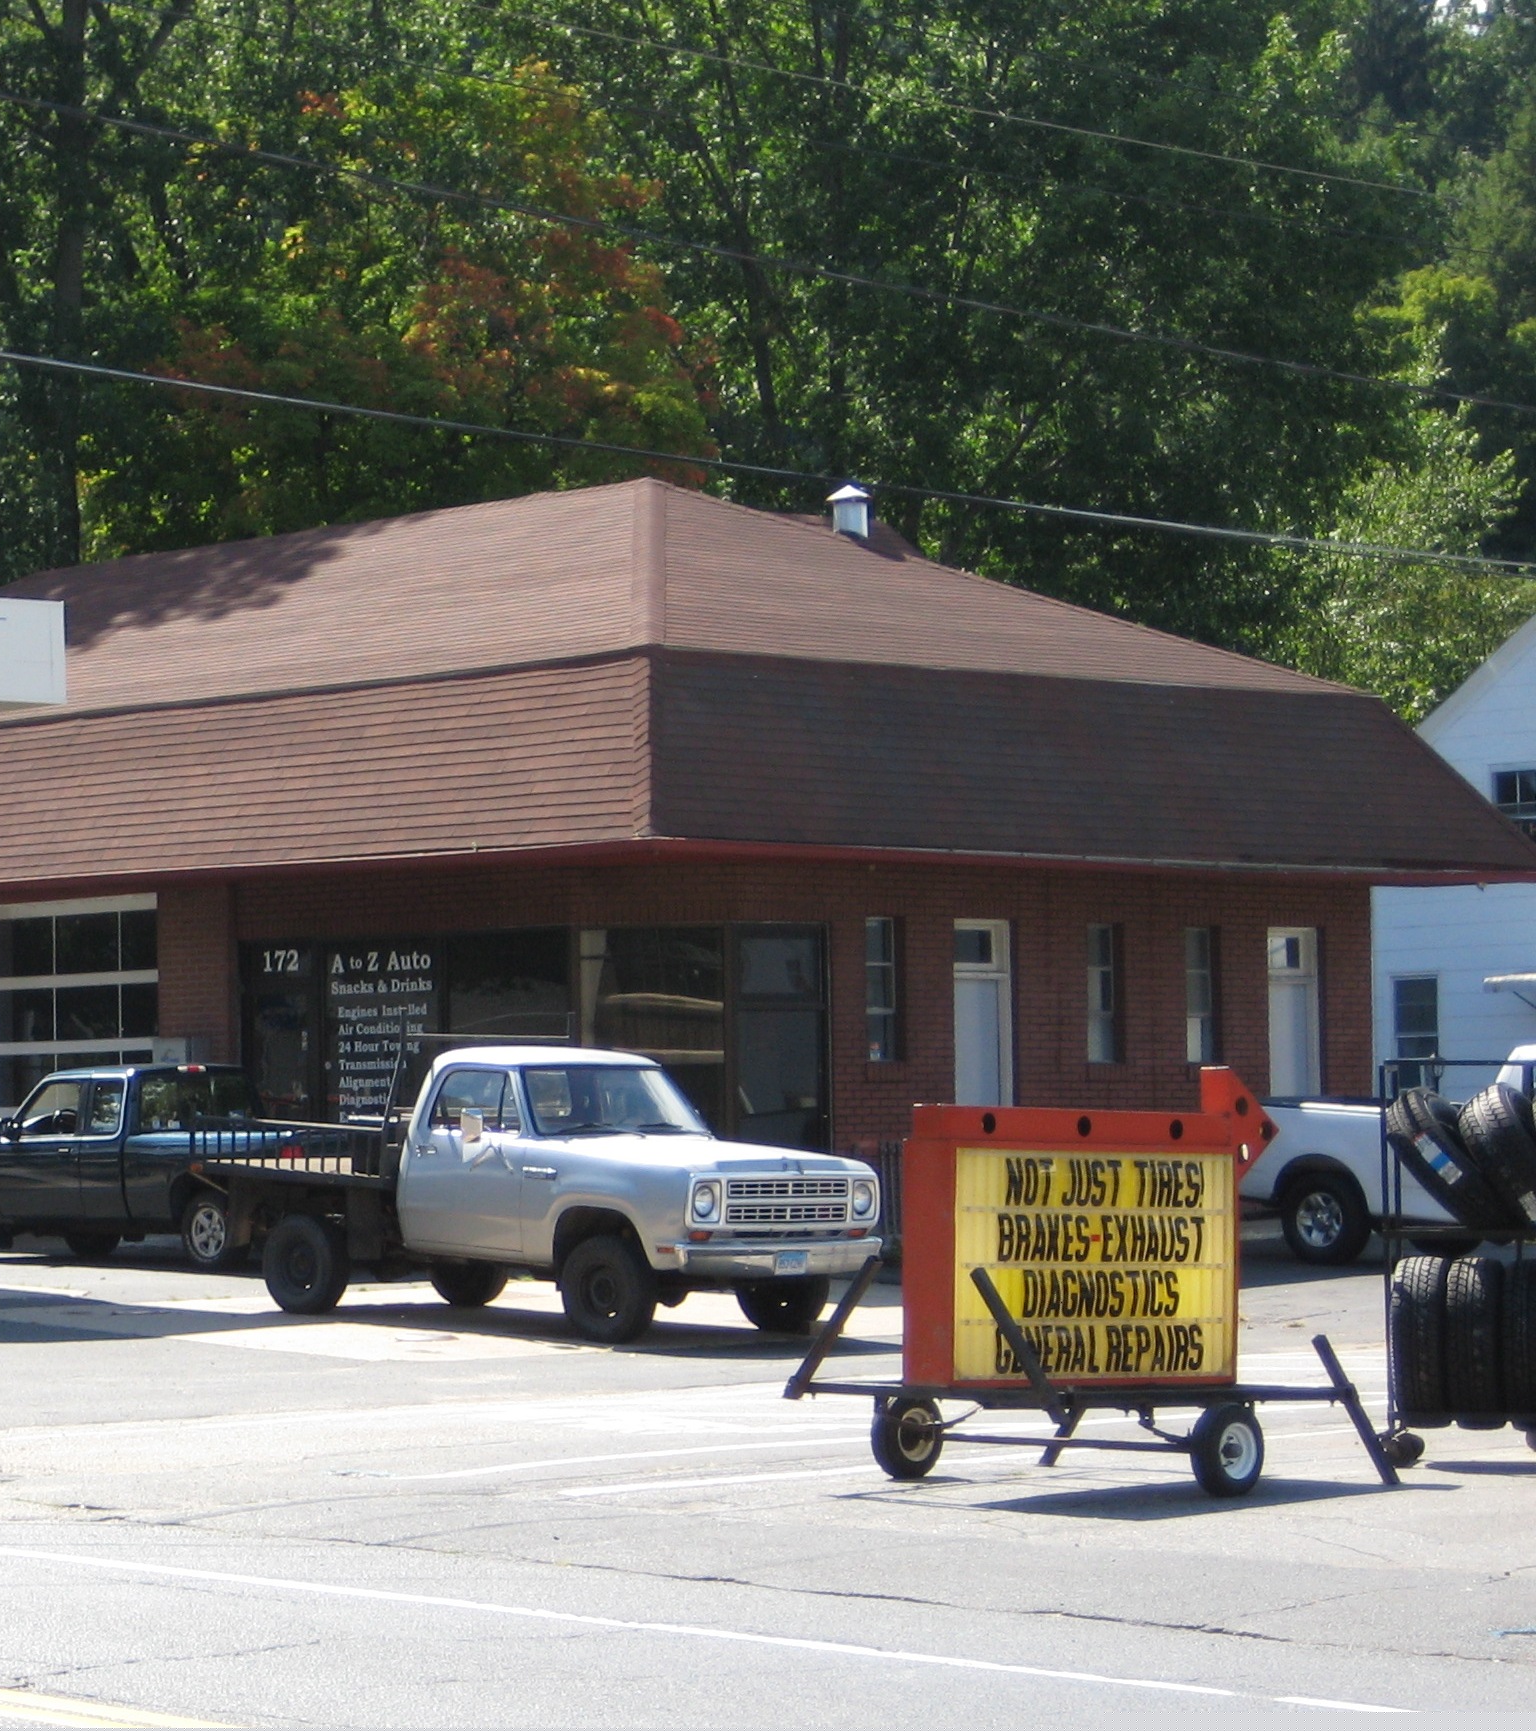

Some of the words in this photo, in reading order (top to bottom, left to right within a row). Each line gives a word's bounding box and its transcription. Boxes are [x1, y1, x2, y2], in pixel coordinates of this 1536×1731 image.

[264, 950, 299, 972] 172
[331, 953, 345, 974] A
[350, 956, 363, 970] to
[367, 951, 379, 971] Z
[387, 950, 432, 971] Auto
[331, 980, 374, 995] Snacks
[377, 980, 387, 993] &
[391, 977, 433, 993] Drinks
[338, 1006, 378, 1021] Engines
[382, 1003, 427, 1016] Instlled
[338, 1024, 354, 1036] Air
[356, 1020, 424, 1034] Conditioing
[338, 1041, 351, 1053] 24
[354, 1041, 379, 1052] Hour
[382, 1040, 420, 1054] Towng
[338, 1076, 392, 1091] Alignment
[1005, 1157, 1055, 1206] NOT
[1061, 1159, 1122, 1207] JUST
[1134, 1160, 1205, 1208] TIRES!
[1022, 1269, 1180, 1318] DIAGNOSTICS
[1105, 1324, 1205, 1373] REPAIRS
